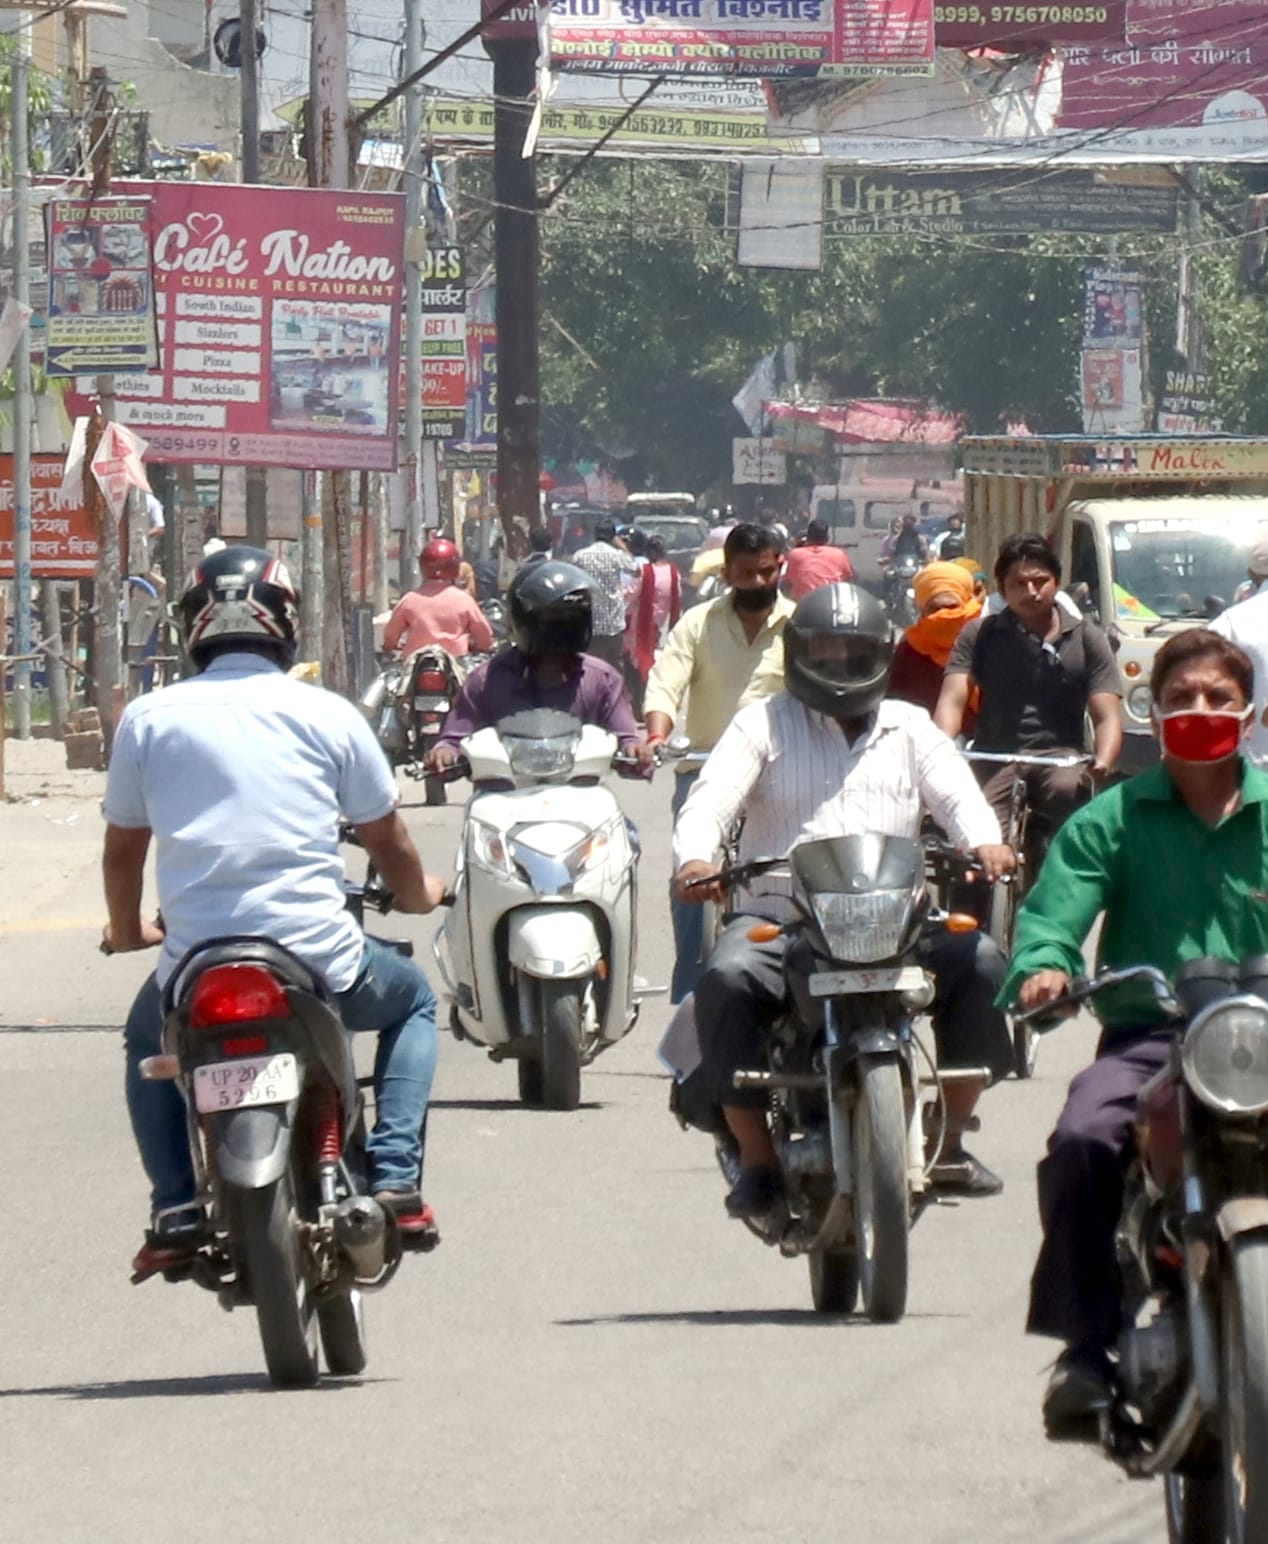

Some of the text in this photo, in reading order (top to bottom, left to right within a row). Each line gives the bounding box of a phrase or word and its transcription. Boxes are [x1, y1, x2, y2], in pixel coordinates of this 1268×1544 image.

[827, 175, 963, 217] Uttam
[833, 220, 872, 233] Color
[918, 216, 964, 233] Studio
[154, 222, 395, 282] Café Nation
[181, 275, 259, 290] CUISINE
[272, 280, 395, 297] RESTAURANT
[183, 300, 256, 313] South Indian
[196, 326, 239, 340] Sizzlers
[202, 356, 232, 368] Pizza
[190, 381, 246, 396] Mocktails
[211, 1063, 282, 1087] UP 20 AA
[219, 1083, 277, 1106] 5296
